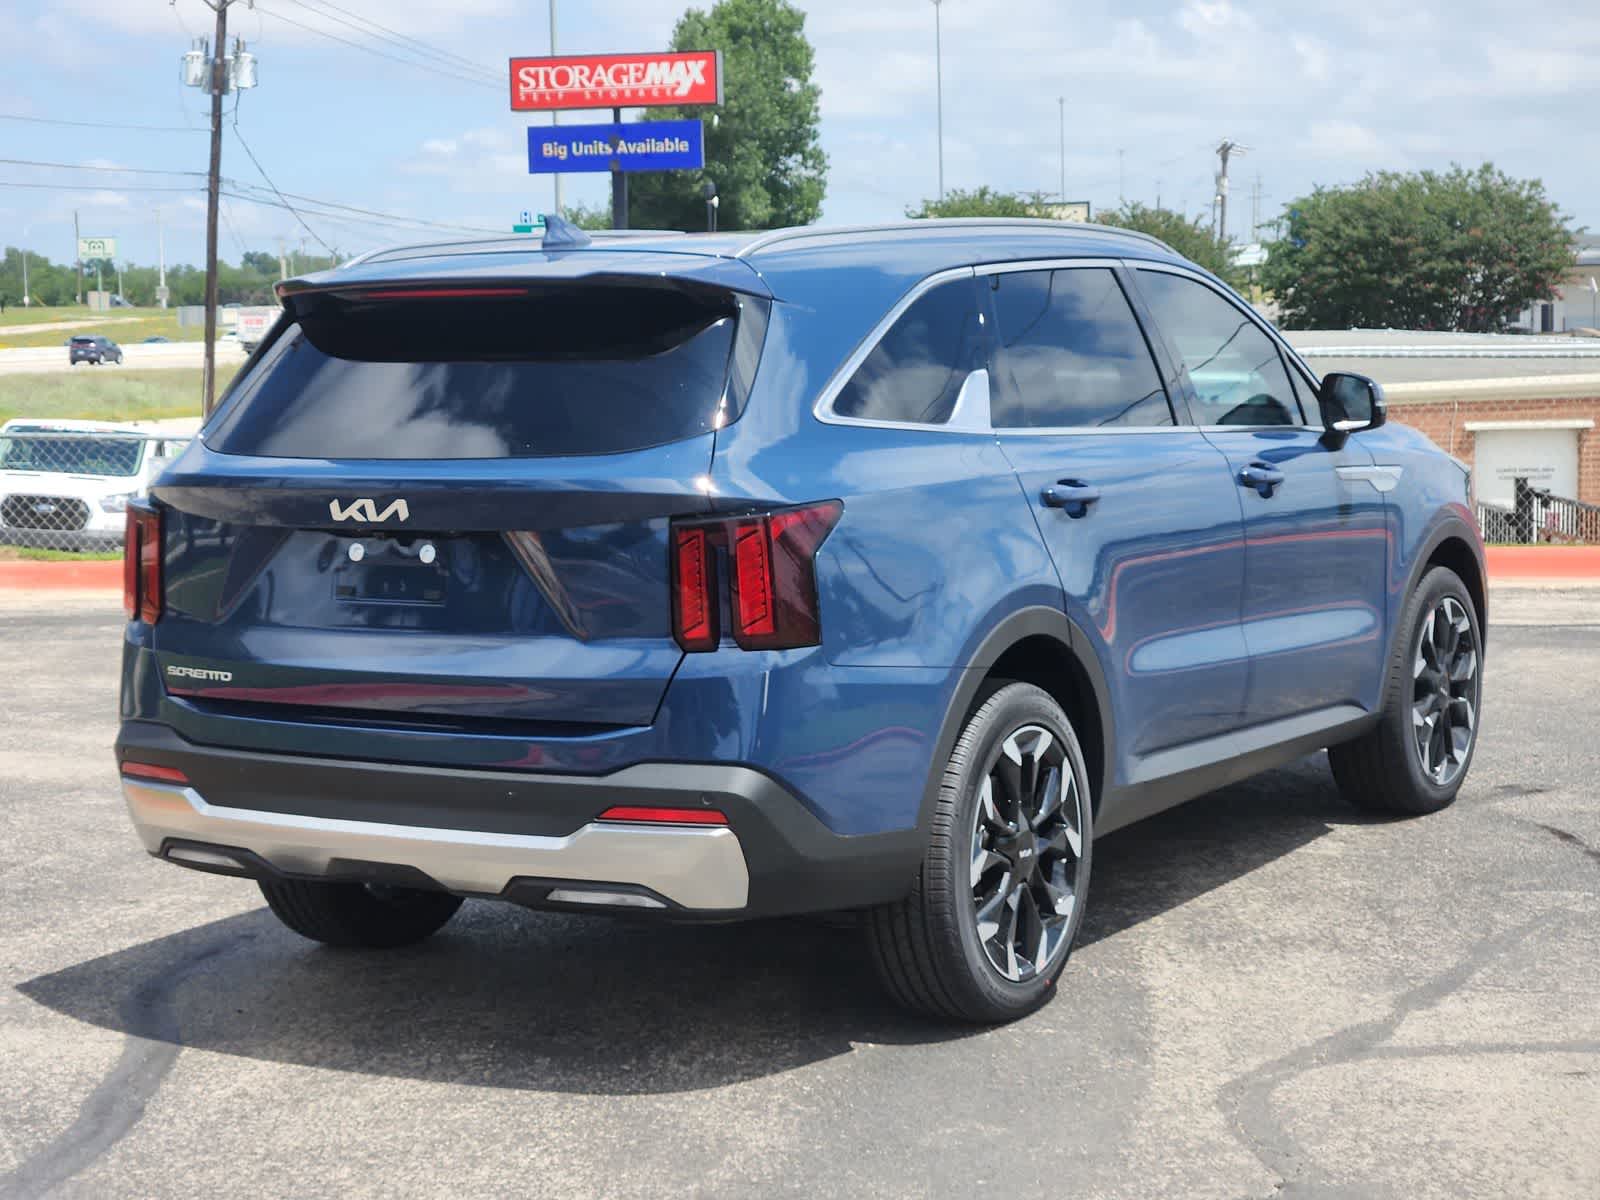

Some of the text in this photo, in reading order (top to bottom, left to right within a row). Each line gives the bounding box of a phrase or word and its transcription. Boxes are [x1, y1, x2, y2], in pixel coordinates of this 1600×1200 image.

[542, 138, 689, 160] Big Units Available
[329, 498, 409, 522] KIA
[167, 666, 233, 682] SORENTO
